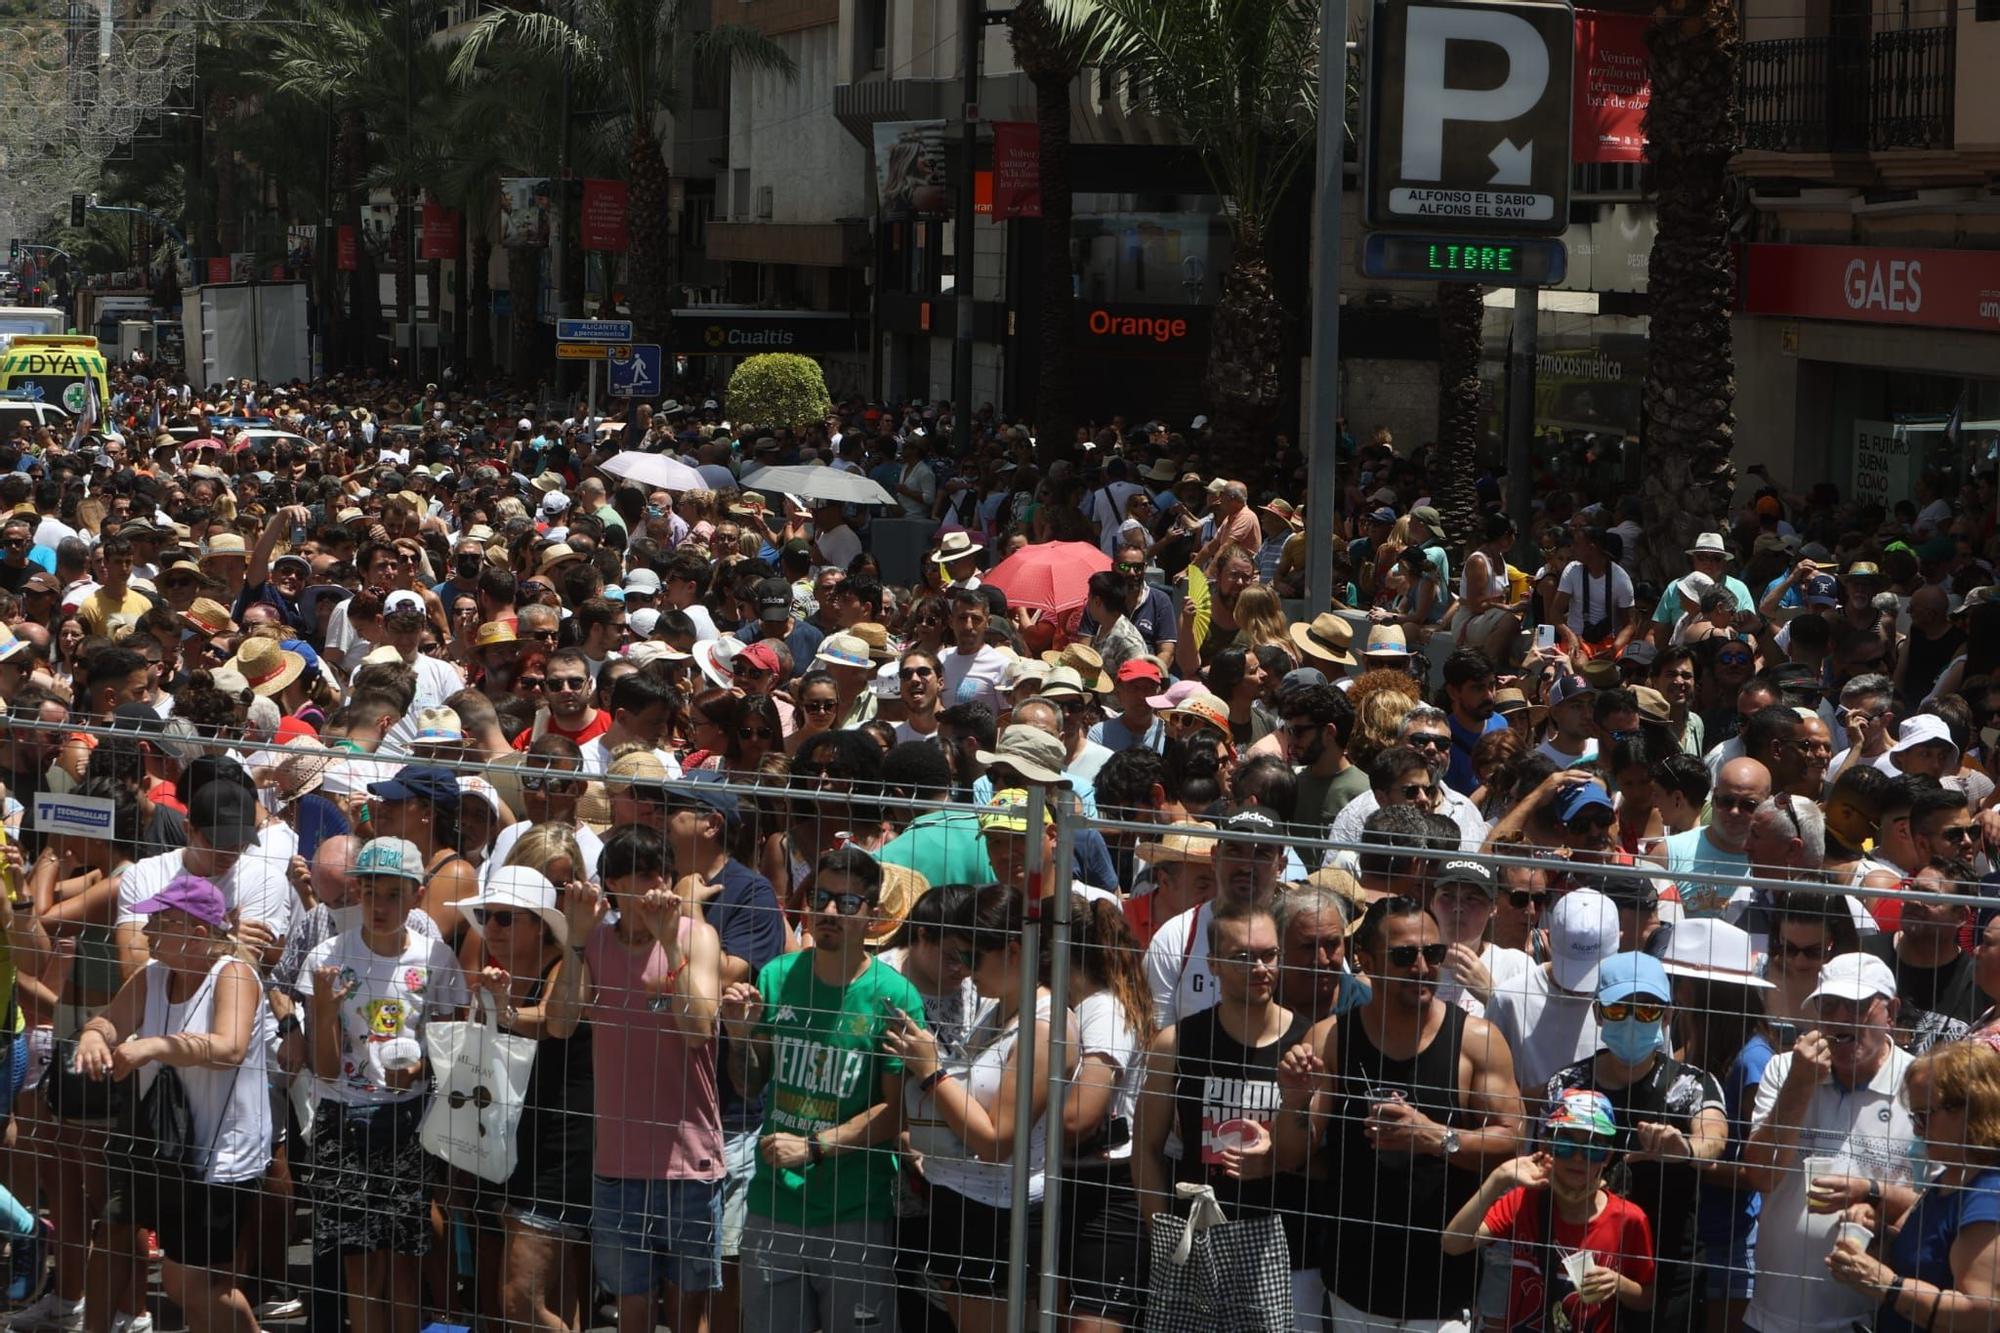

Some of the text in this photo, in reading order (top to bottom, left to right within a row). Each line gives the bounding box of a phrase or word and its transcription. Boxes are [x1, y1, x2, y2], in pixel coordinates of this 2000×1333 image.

[1400, 5, 1550, 182] P
[1588, 95, 1609, 107] bar
[1611, 95, 1625, 108] de
[1408, 190, 1535, 207] ALFONSO EL SABIO
[1418, 203, 1525, 218] ALFONS EL SAVI
[1429, 245, 1513, 271] LIBRE
[1844, 258, 1922, 313] GAES
[1979, 301, 2000, 324] am
[1089, 309, 1187, 343] Orange
[728, 329, 793, 344] Cualtis
[30, 355, 78, 374] DYA
[1859, 433, 1911, 456] EL FUTURO
[1858, 453, 1889, 473] SUENA
[1857, 473, 1888, 492] COMO
